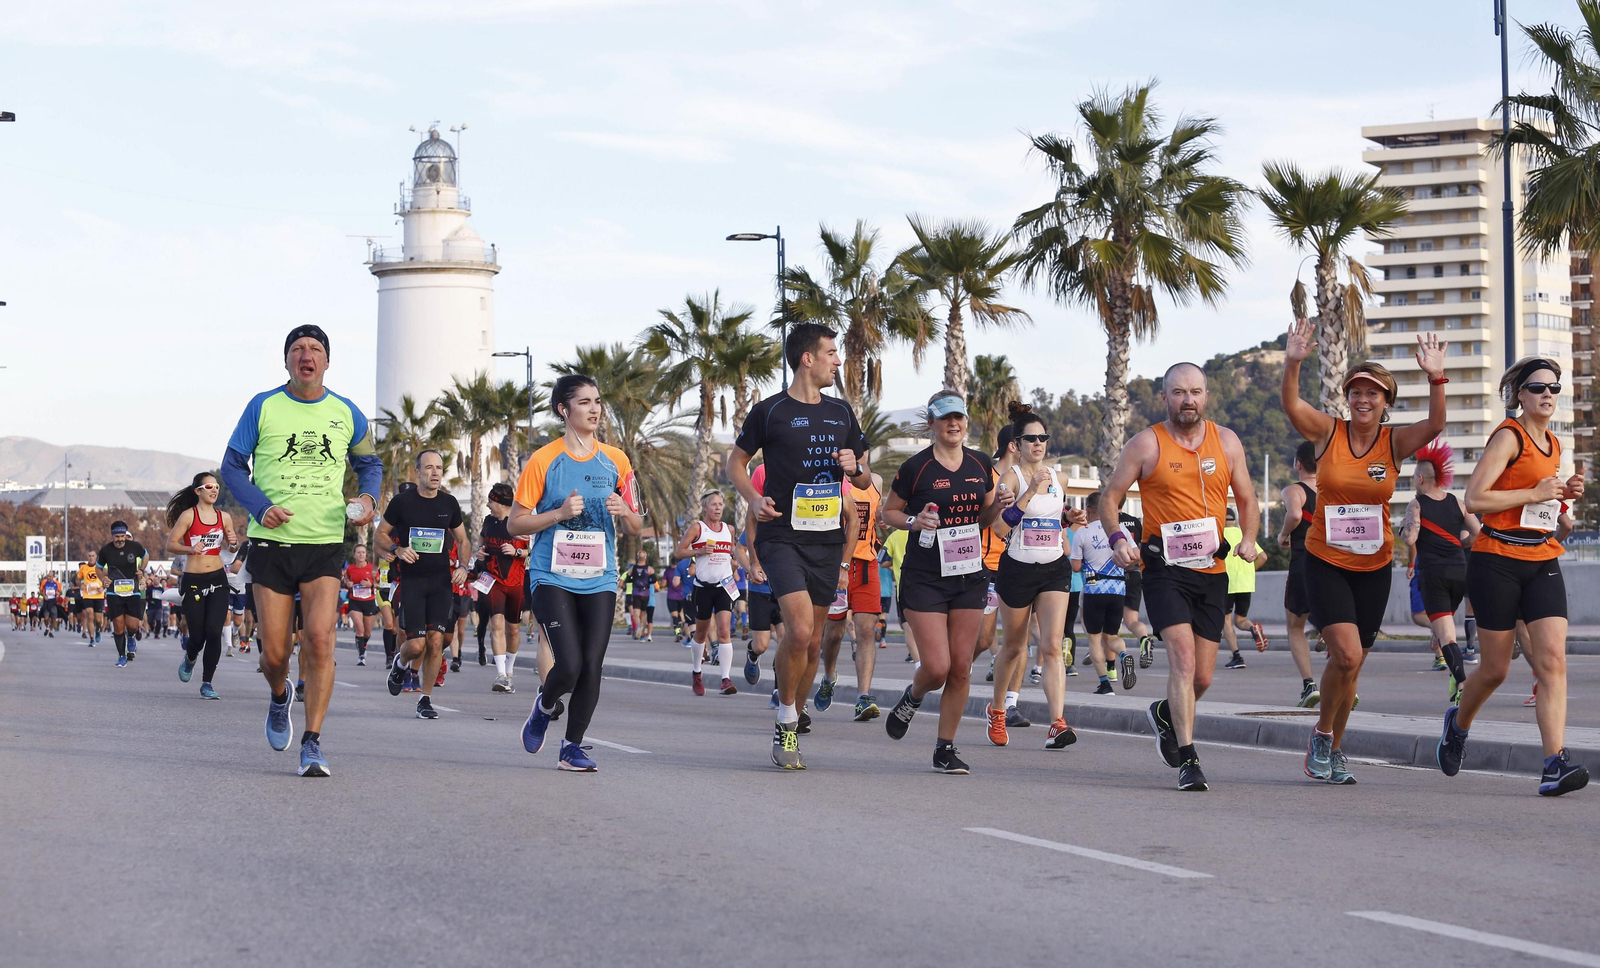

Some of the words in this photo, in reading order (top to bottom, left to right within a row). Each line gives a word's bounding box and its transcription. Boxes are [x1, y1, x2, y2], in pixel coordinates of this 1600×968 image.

[803, 459, 839, 467] WORL
[953, 493, 976, 501] RUN
[949, 505, 979, 513] YOUR
[1346, 526, 1365, 534] 4493
[958, 546, 973, 554] 4542
[1183, 542, 1202, 551] 4546
[571, 552, 590, 560] 4473
